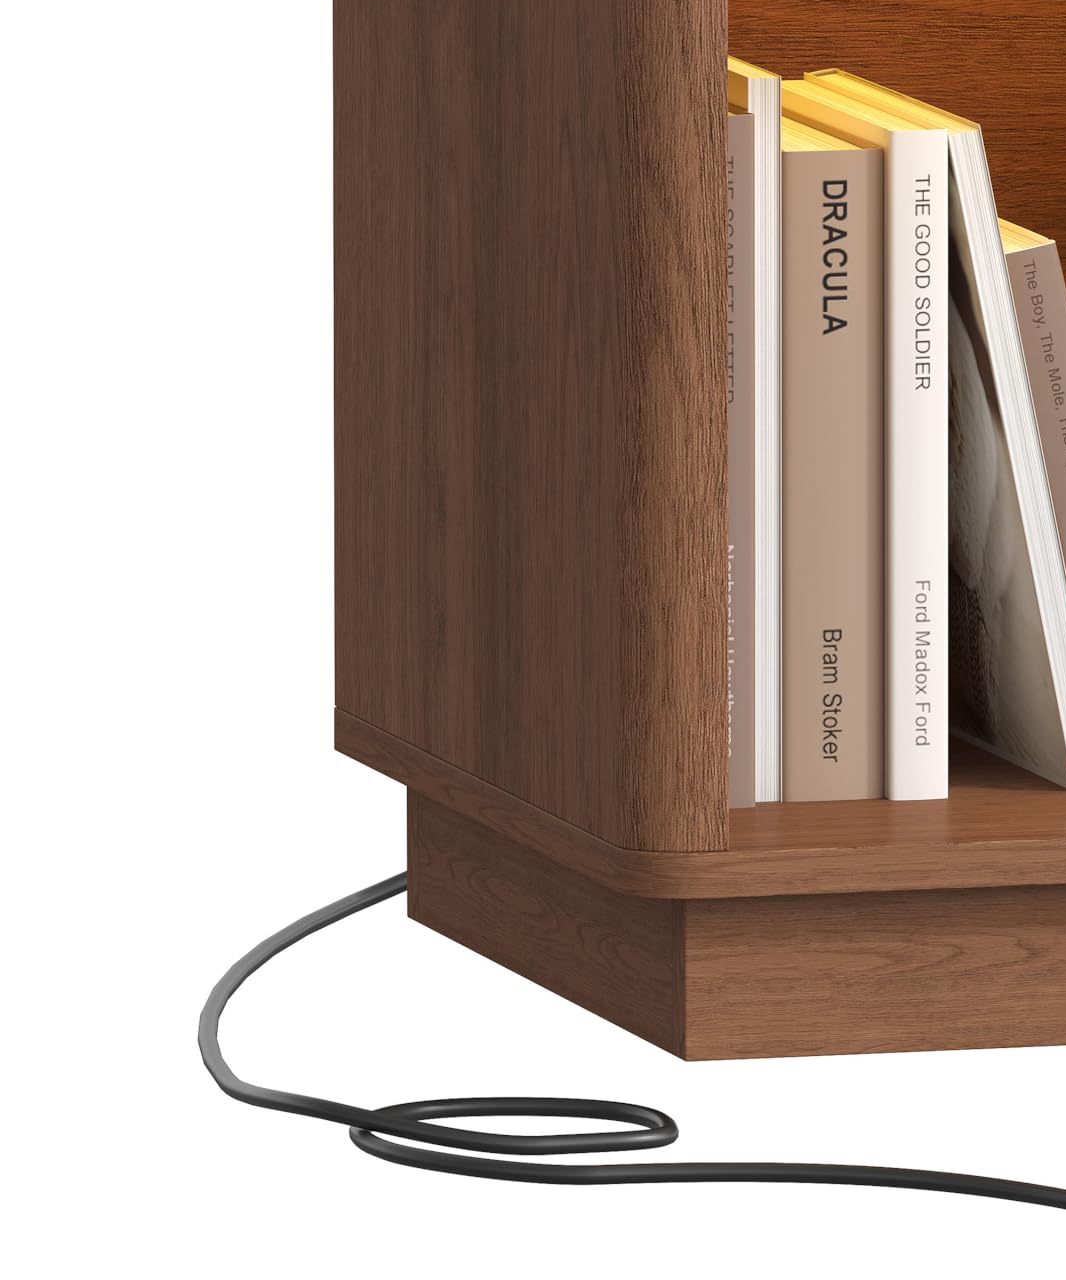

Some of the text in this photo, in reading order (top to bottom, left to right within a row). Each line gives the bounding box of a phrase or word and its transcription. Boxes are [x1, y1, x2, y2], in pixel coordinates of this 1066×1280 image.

[821, 179, 849, 336] DRACULA
[914, 173, 932, 391] THE GOOD SOLDIER
[1023, 257, 1038, 290] The
[1040, 331, 1055, 364] The
[821, 628, 843, 763] Bram Stoker
[914, 579, 932, 747] Ford Madox Ford
